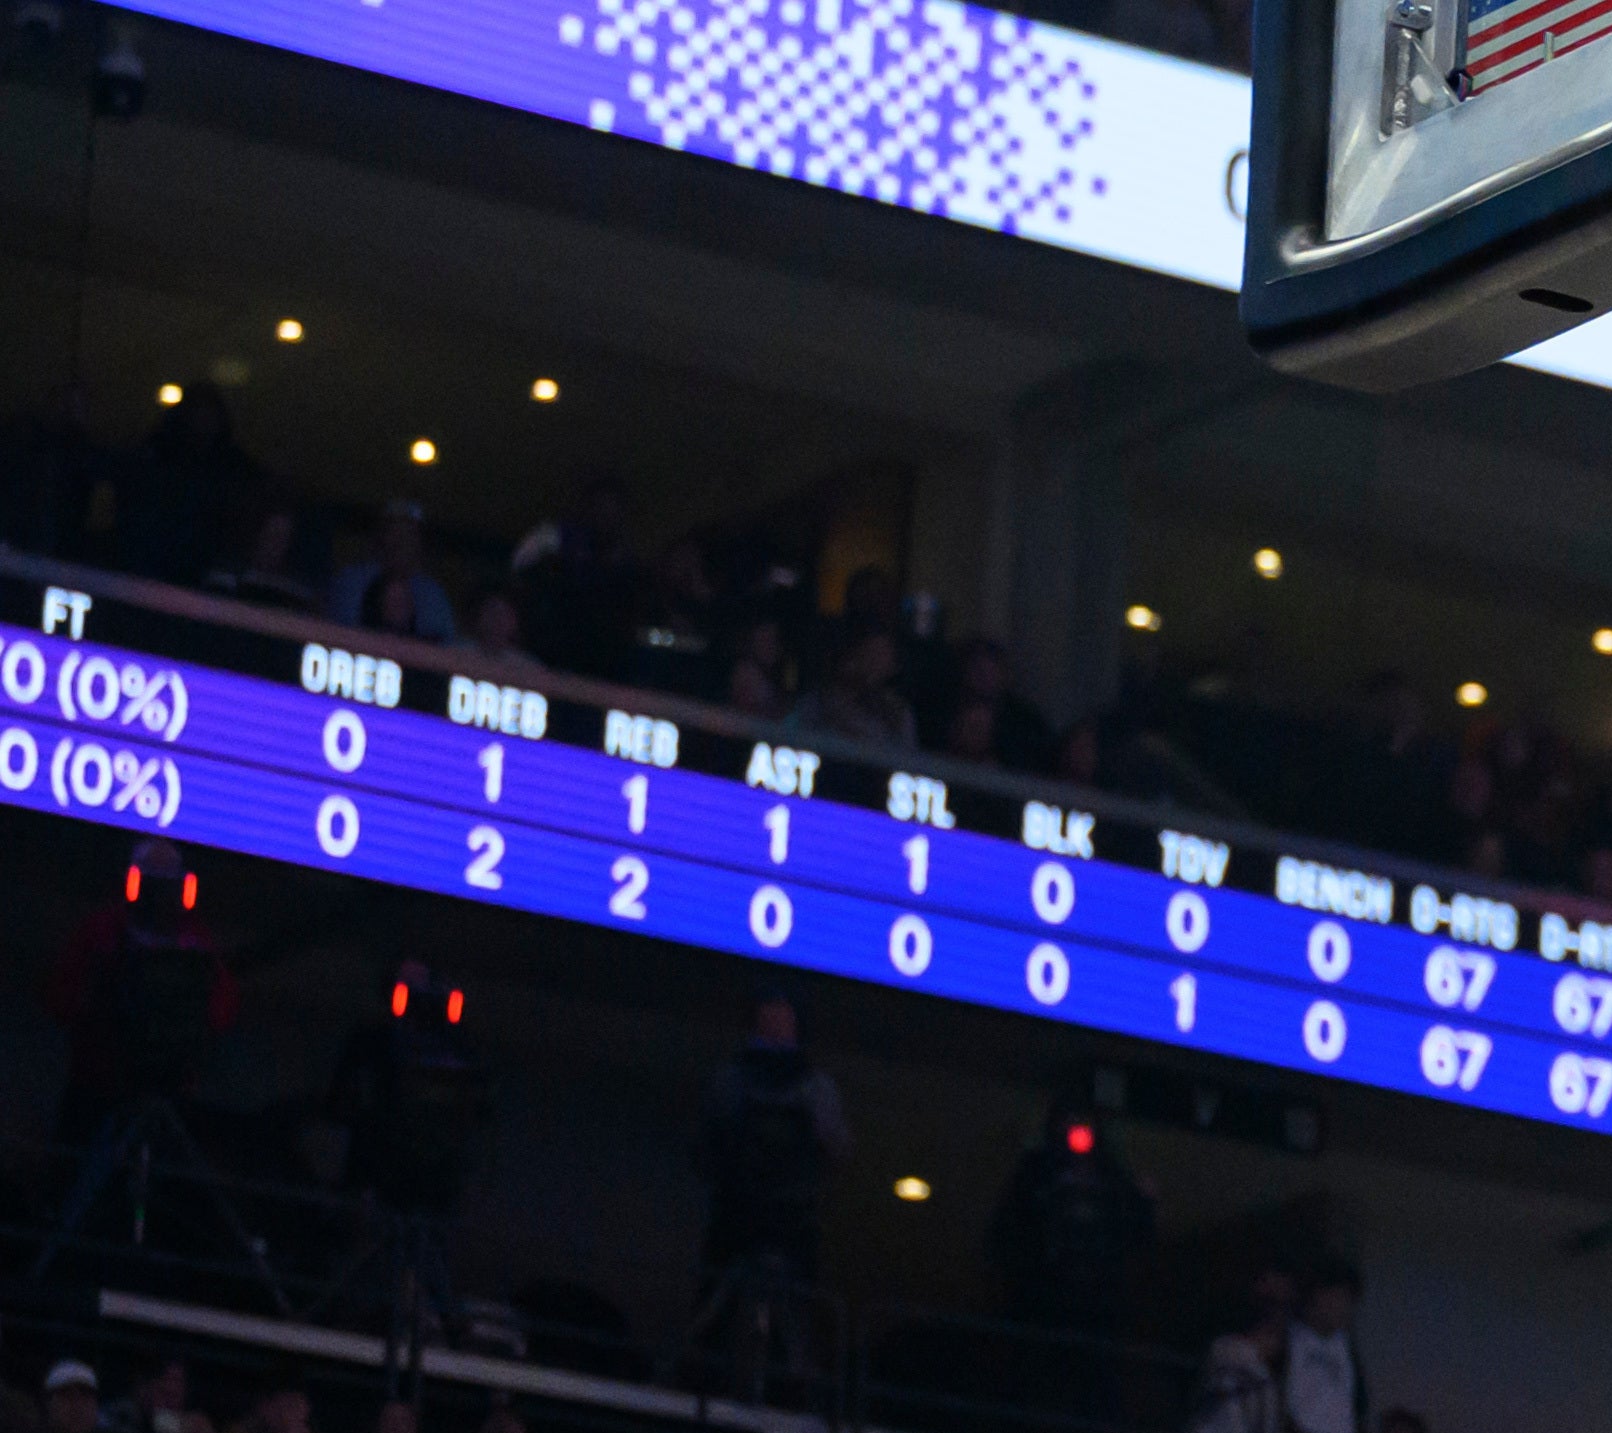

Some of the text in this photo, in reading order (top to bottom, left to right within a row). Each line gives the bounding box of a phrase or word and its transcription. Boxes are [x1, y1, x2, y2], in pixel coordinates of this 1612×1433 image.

[42, 586, 92, 640] FT
[605, 708, 679, 768] REB
[746, 742, 821, 797] AST
[887, 770, 954, 829] STL
[1022, 800, 1093, 858] BLK
[1276, 855, 1394, 924] BENCH
[50, 736, 182, 828] (0%)
[316, 794, 360, 858] 0
[465, 825, 504, 890] 2
[608, 854, 648, 920] 2
[749, 884, 793, 948] 0
[889, 914, 932, 977] 0
[1026, 942, 1070, 1005] 0
[1170, 971, 1196, 1032] 1
[1303, 999, 1347, 1063] 0
[1420, 1024, 1493, 1091] 67
[57, 649, 189, 742] (0%)
[322, 708, 367, 773] 0
[478, 743, 506, 802] 1
[623, 773, 649, 834] 1
[764, 803, 791, 863] 1
[903, 834, 928, 894] 1
[1031, 860, 1075, 925] 0
[1166, 890, 1210, 953] 0
[1307, 920, 1352, 983] 0
[1424, 945, 1497, 1012] 67
